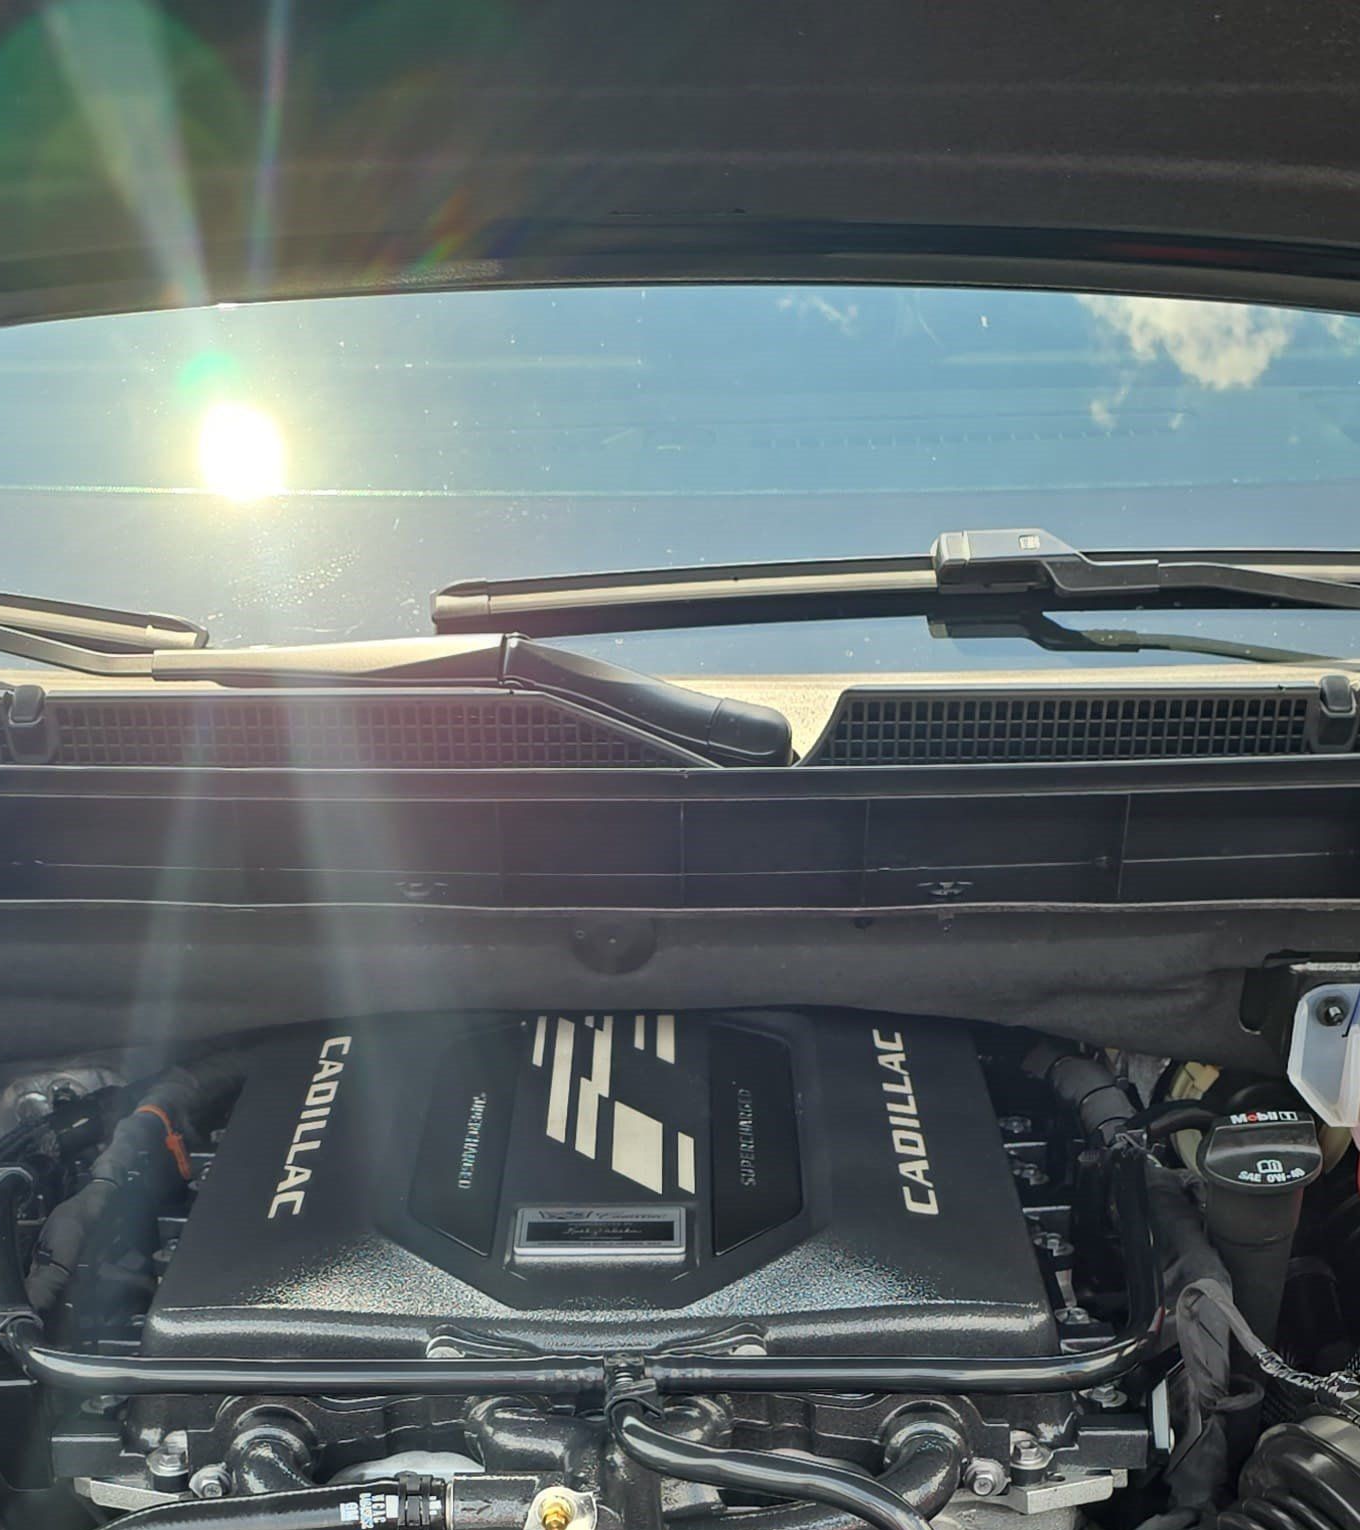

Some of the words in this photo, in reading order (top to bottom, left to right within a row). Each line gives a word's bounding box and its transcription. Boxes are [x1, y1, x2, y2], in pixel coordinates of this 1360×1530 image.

[267, 1036, 353, 1220] CADILLAC
[737, 1087, 757, 1187] SUPERCHARGED
[872, 1028, 939, 1215] CADILLAC
[1229, 1110, 1278, 1125] Mobil
[1237, 1169, 1262, 1183] SAE
